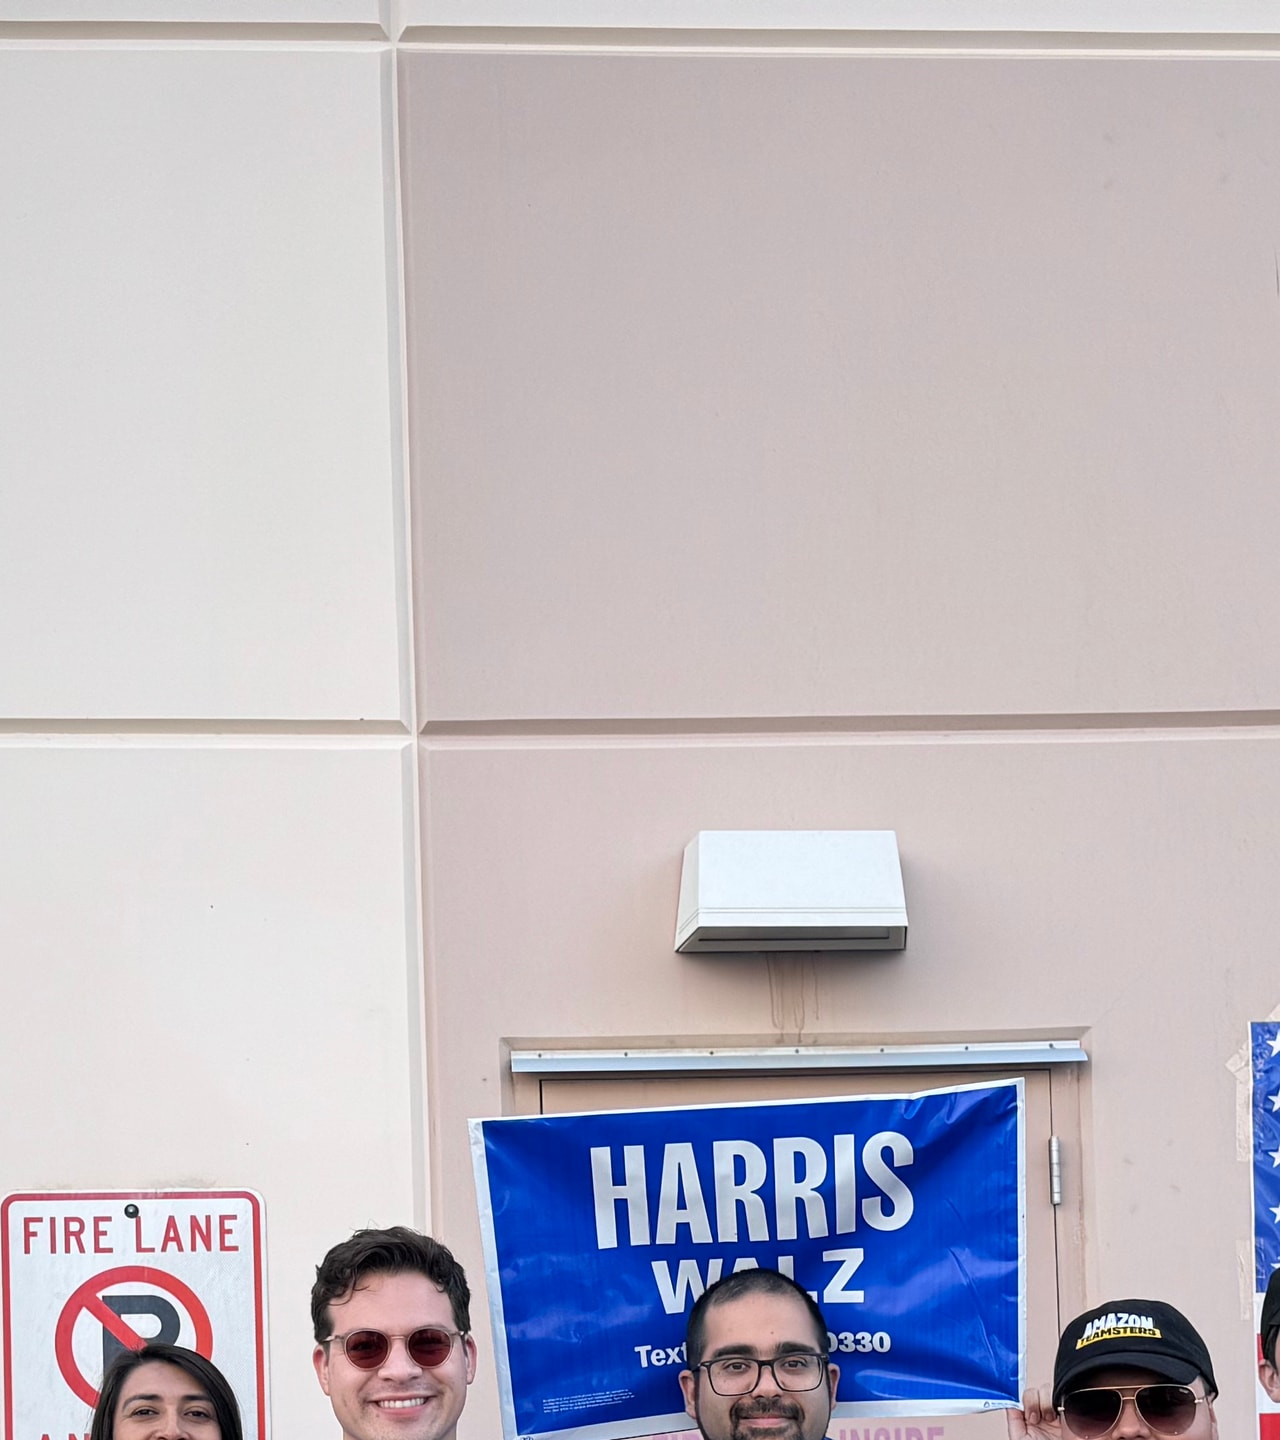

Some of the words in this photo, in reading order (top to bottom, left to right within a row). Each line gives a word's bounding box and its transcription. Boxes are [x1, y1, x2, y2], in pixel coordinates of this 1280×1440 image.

[589, 1130, 914, 1250] HARRIS
[23, 1216, 114, 1255] FIRE
[135, 1214, 239, 1254] LANE
[1080, 1327, 1157, 1346] TEAMSTERS
[1082, 1312, 1154, 1338] AMAZON
[827, 1331, 891, 1353] 0330
